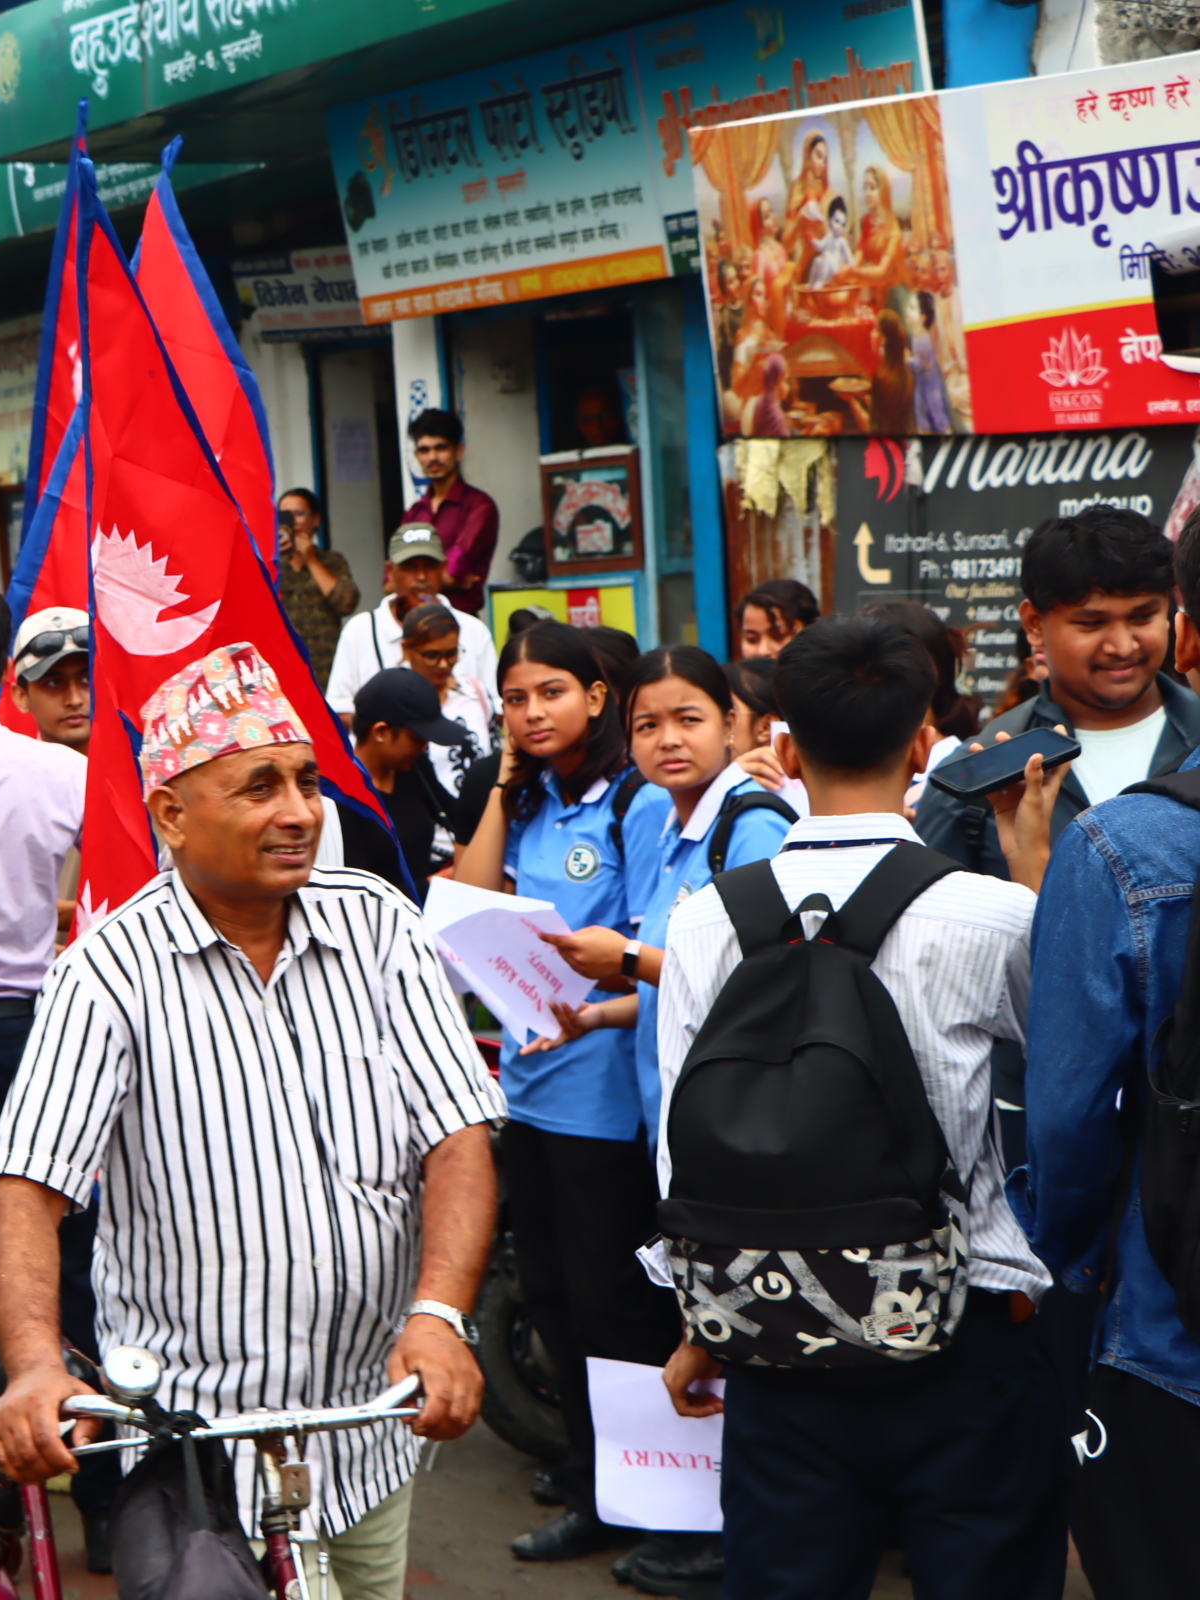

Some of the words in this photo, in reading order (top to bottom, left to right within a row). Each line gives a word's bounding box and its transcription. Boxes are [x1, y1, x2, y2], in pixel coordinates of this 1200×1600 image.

[1075, 89, 1099, 123] हरे
[1107, 86, 1155, 122] कृष्ण
[1164, 75, 1190, 110] हरे
[1049, 393, 1103, 409] ISKCON
[1054, 412, 1101, 425] ITAHARI
[922, 432, 1153, 494] Martina
[945, 583, 968, 599] Our
[619, 1449, 713, 1470] LUXURY
